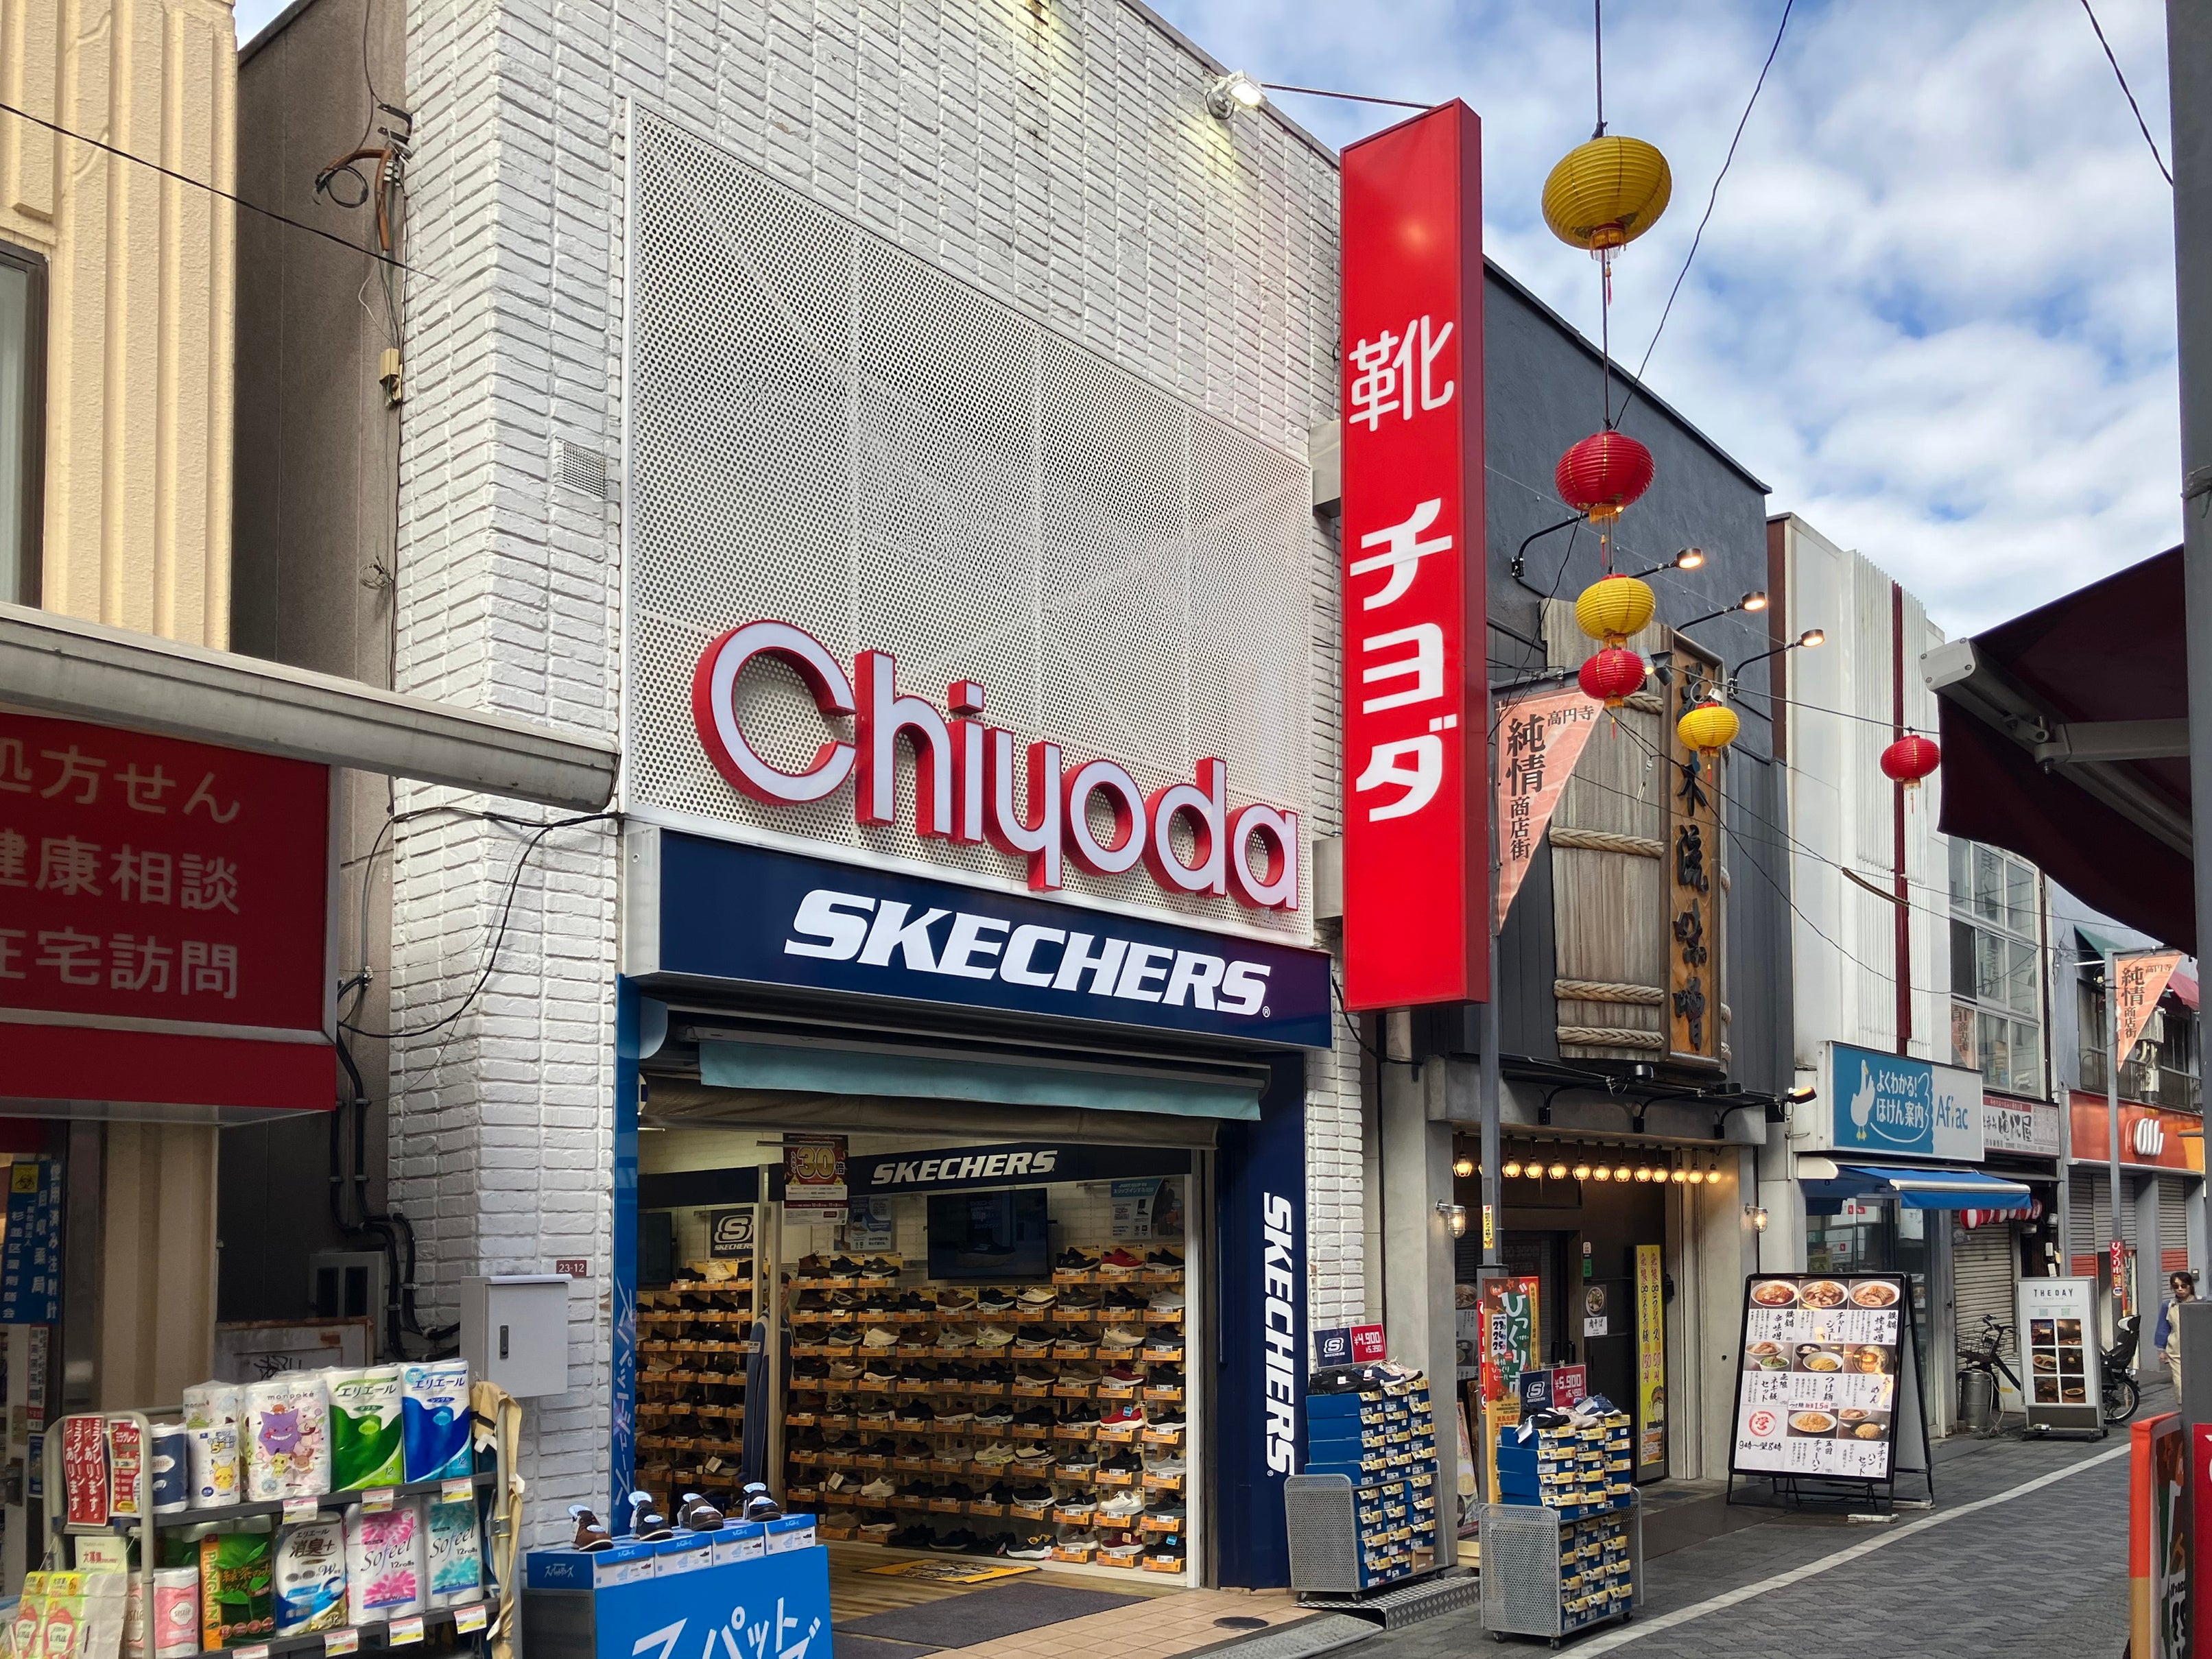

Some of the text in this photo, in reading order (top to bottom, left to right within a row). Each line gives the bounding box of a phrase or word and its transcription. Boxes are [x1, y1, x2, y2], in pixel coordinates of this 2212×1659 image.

[1348, 313, 1455, 433] 靴
[1547, 705, 1595, 728] 高円寺
[691, 619, 1298, 911] Chiyoda
[1506, 713, 1547, 862] 純情商店街
[784, 889, 1271, 1016] SKECHERS
[2145, 964, 2173, 973] 高円寺
[2121, 966, 2145, 1038] 純情商店街
[1877, 1069, 1918, 1098] よくわかる!
[1877, 1097, 1925, 1129] ほけん案内
[1936, 1095, 1969, 1130] Aflac
[797, 1147, 835, 1179] 30
[871, 1150, 1058, 1185] SKECHERS
[558, 1263, 584, 1273] 23-12
[2034, 1288, 2073, 1298] THE DAY
[1263, 1191, 1294, 1475] SKECHERS
[1493, 1321, 1503, 1330] 23
[1493, 1331, 1503, 1340] 24
[1493, 1341, 1503, 1350] 25
[337, 1383, 396, 1398] エリエール
[412, 1376, 466, 1389] エリエール
[1823, 1376, 1835, 1401] つけ麺
[267, 1391, 314, 1400] monpoké
[385, 1466, 394, 1475] 12
[457, 1456, 466, 1464] 12
[1858, 1456, 1866, 1476] セット
[296, 1529, 329, 1538] エリエール
[429, 1515, 478, 1562] Sofeel
[360, 1525, 417, 1576] Sofeel
[203, 1551, 219, 1621] PENGUIN
